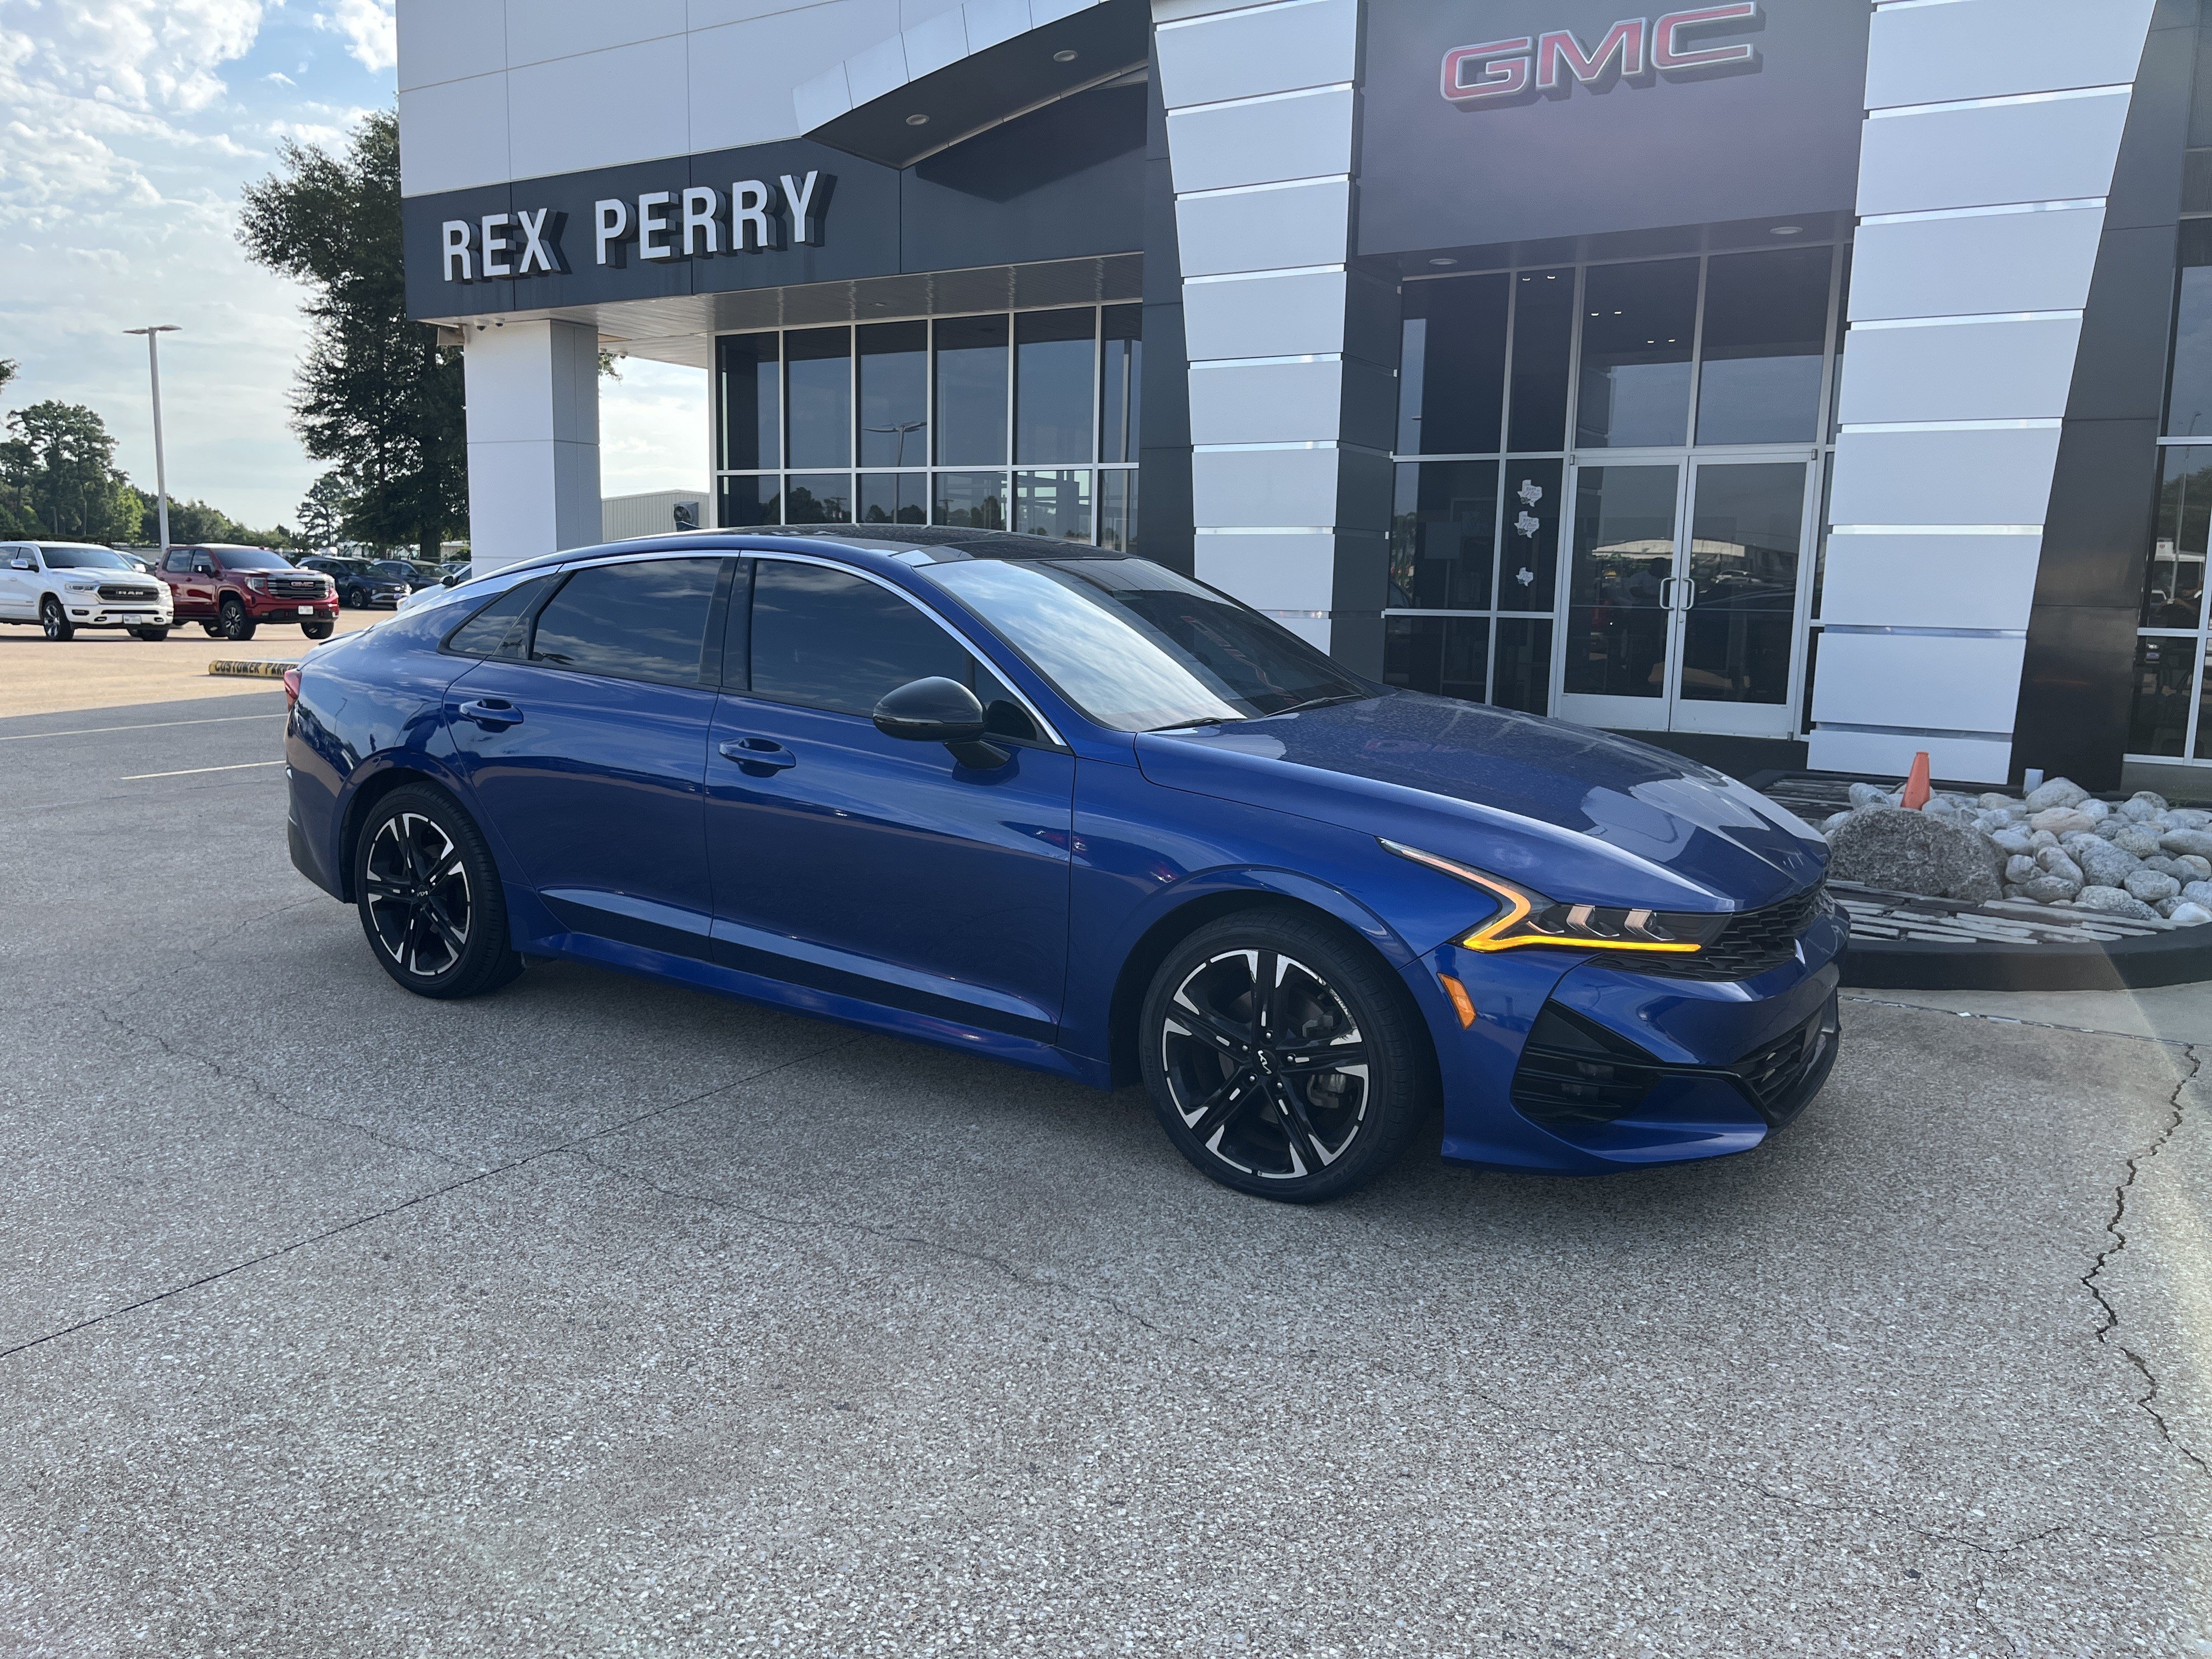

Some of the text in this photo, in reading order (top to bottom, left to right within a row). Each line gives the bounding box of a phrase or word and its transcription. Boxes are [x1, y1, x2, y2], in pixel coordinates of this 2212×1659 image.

[1440, 1, 1756, 101] GMC
[442, 170, 819, 282] REX PERRY
[215, 660, 298, 675] CUSTOMER PARK
